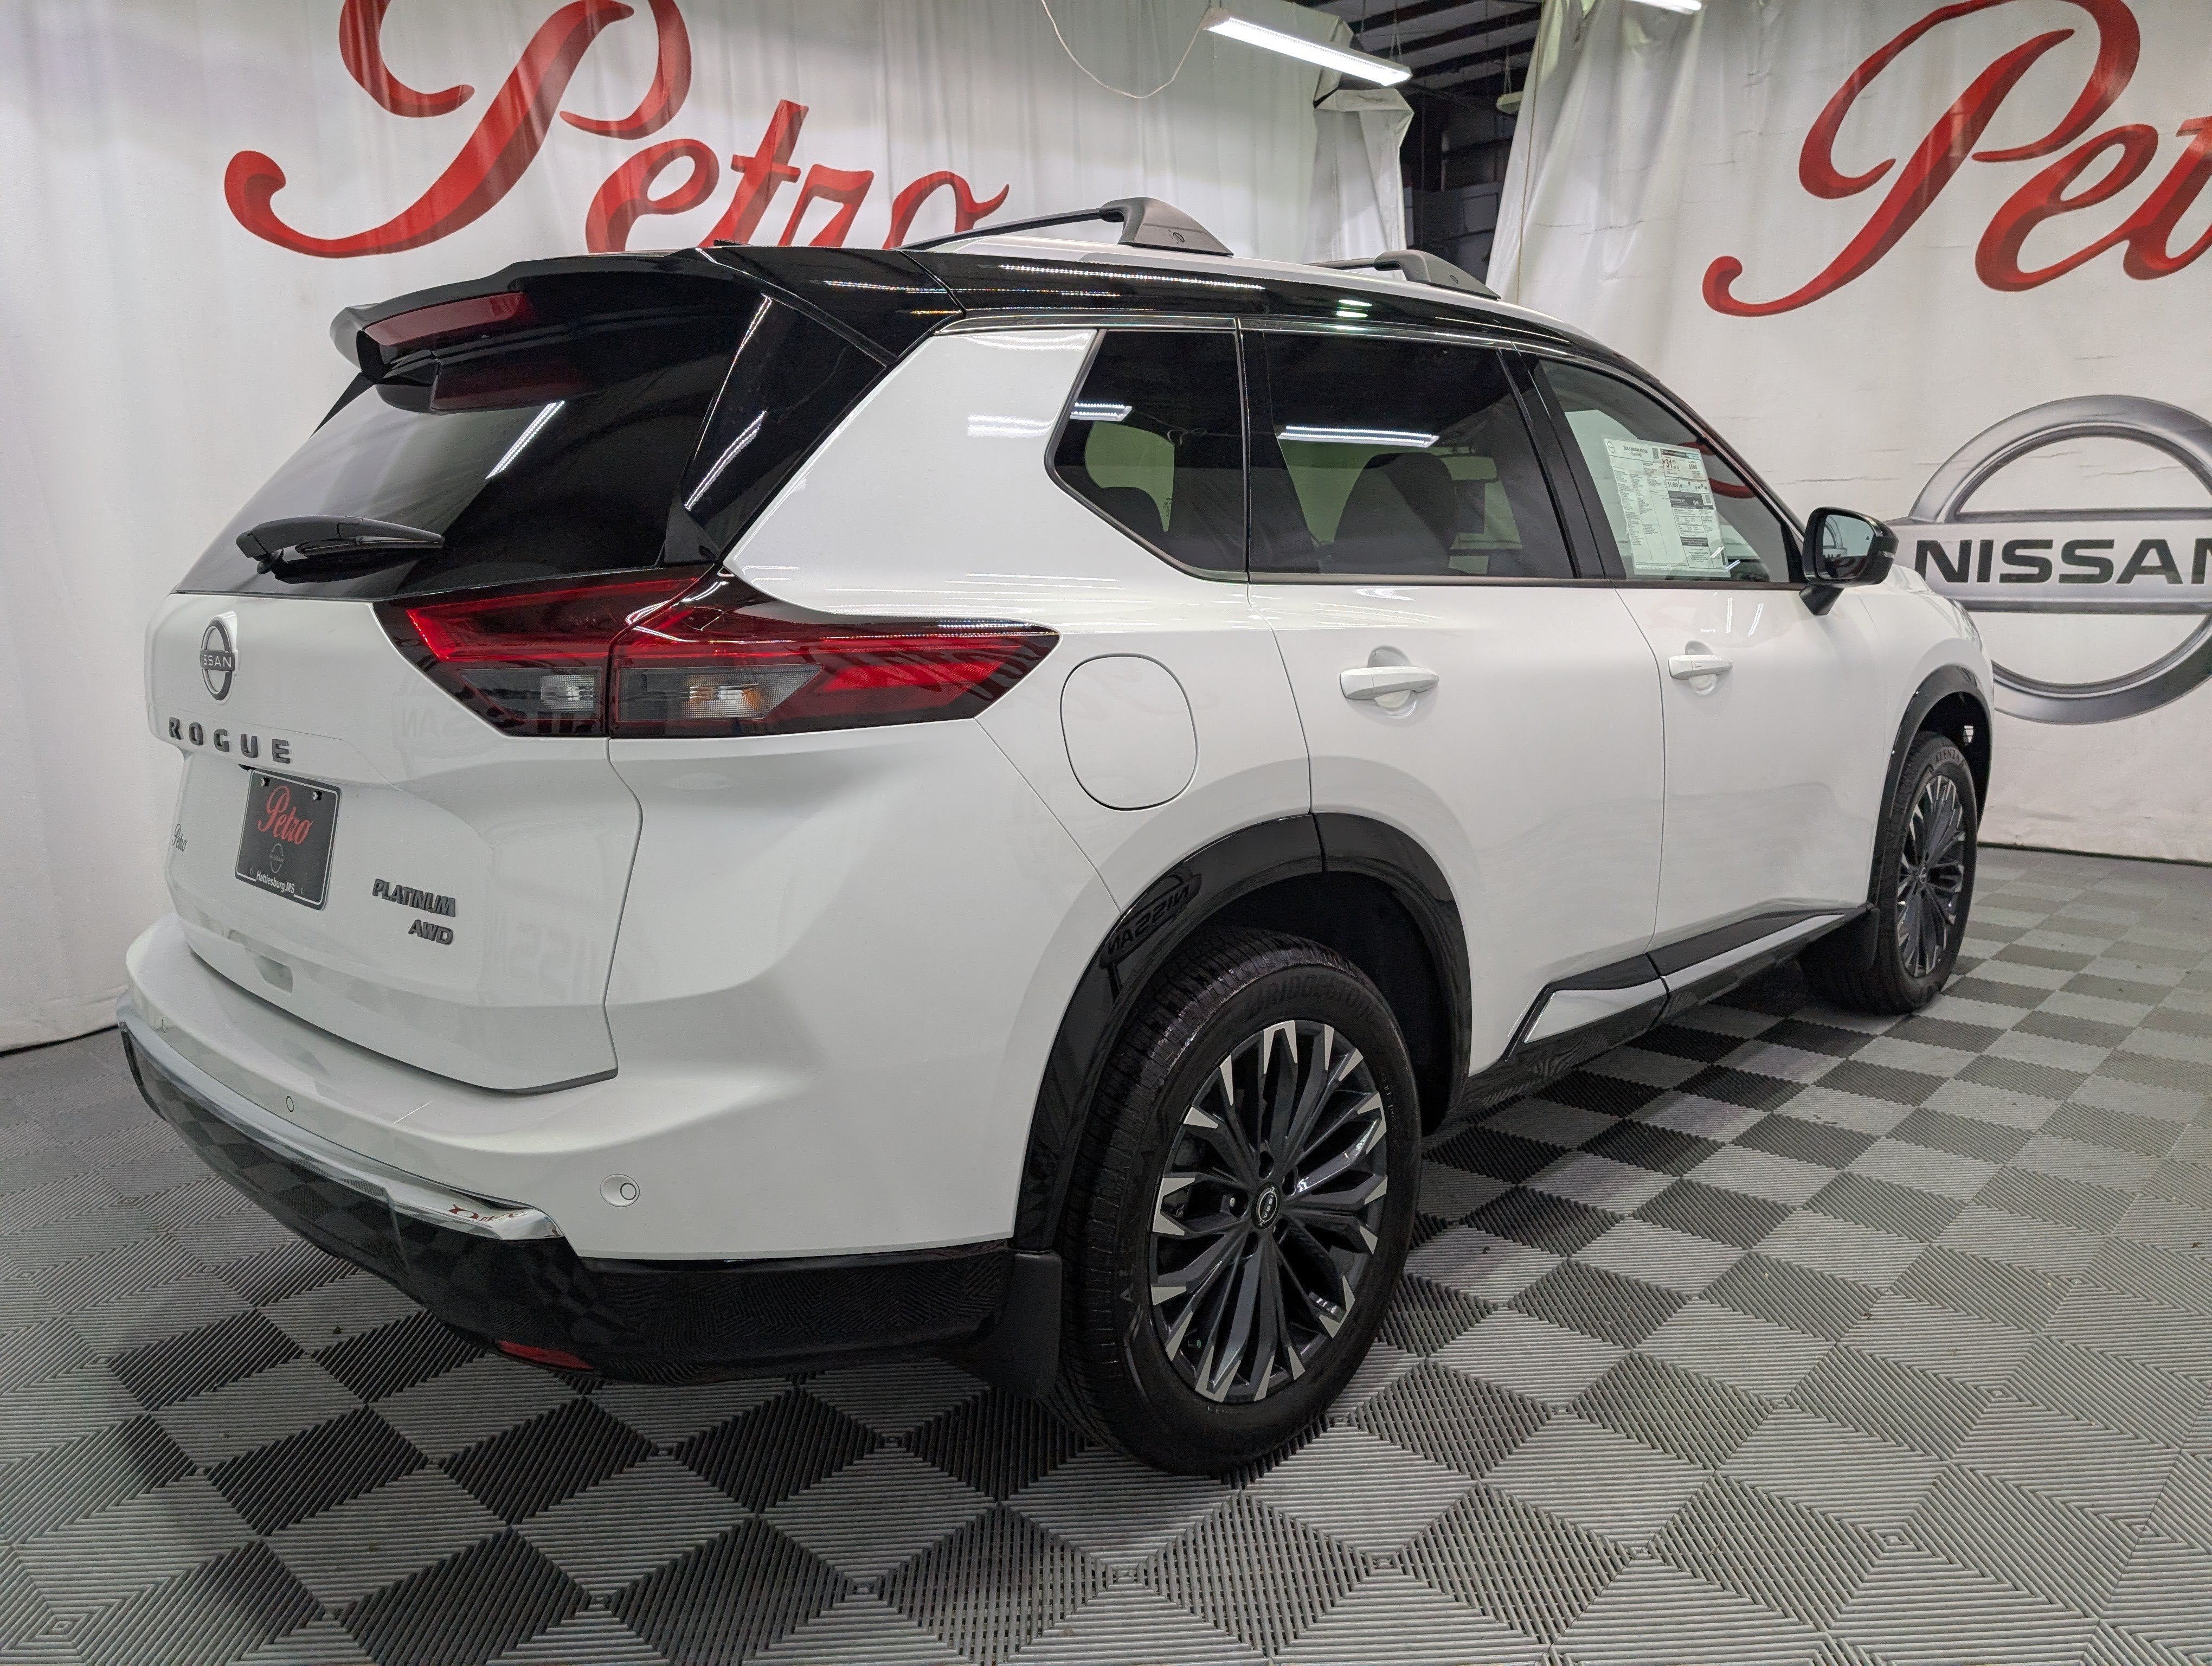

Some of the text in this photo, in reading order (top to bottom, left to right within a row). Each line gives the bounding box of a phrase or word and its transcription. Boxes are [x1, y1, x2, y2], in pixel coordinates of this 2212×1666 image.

[1666, 459, 1673, 468] 31
[169, 717, 291, 764] ROGUE
[257, 786, 314, 844] Petro
[372, 879, 456, 917] PLATINUM
[408, 920, 453, 945] AWD
